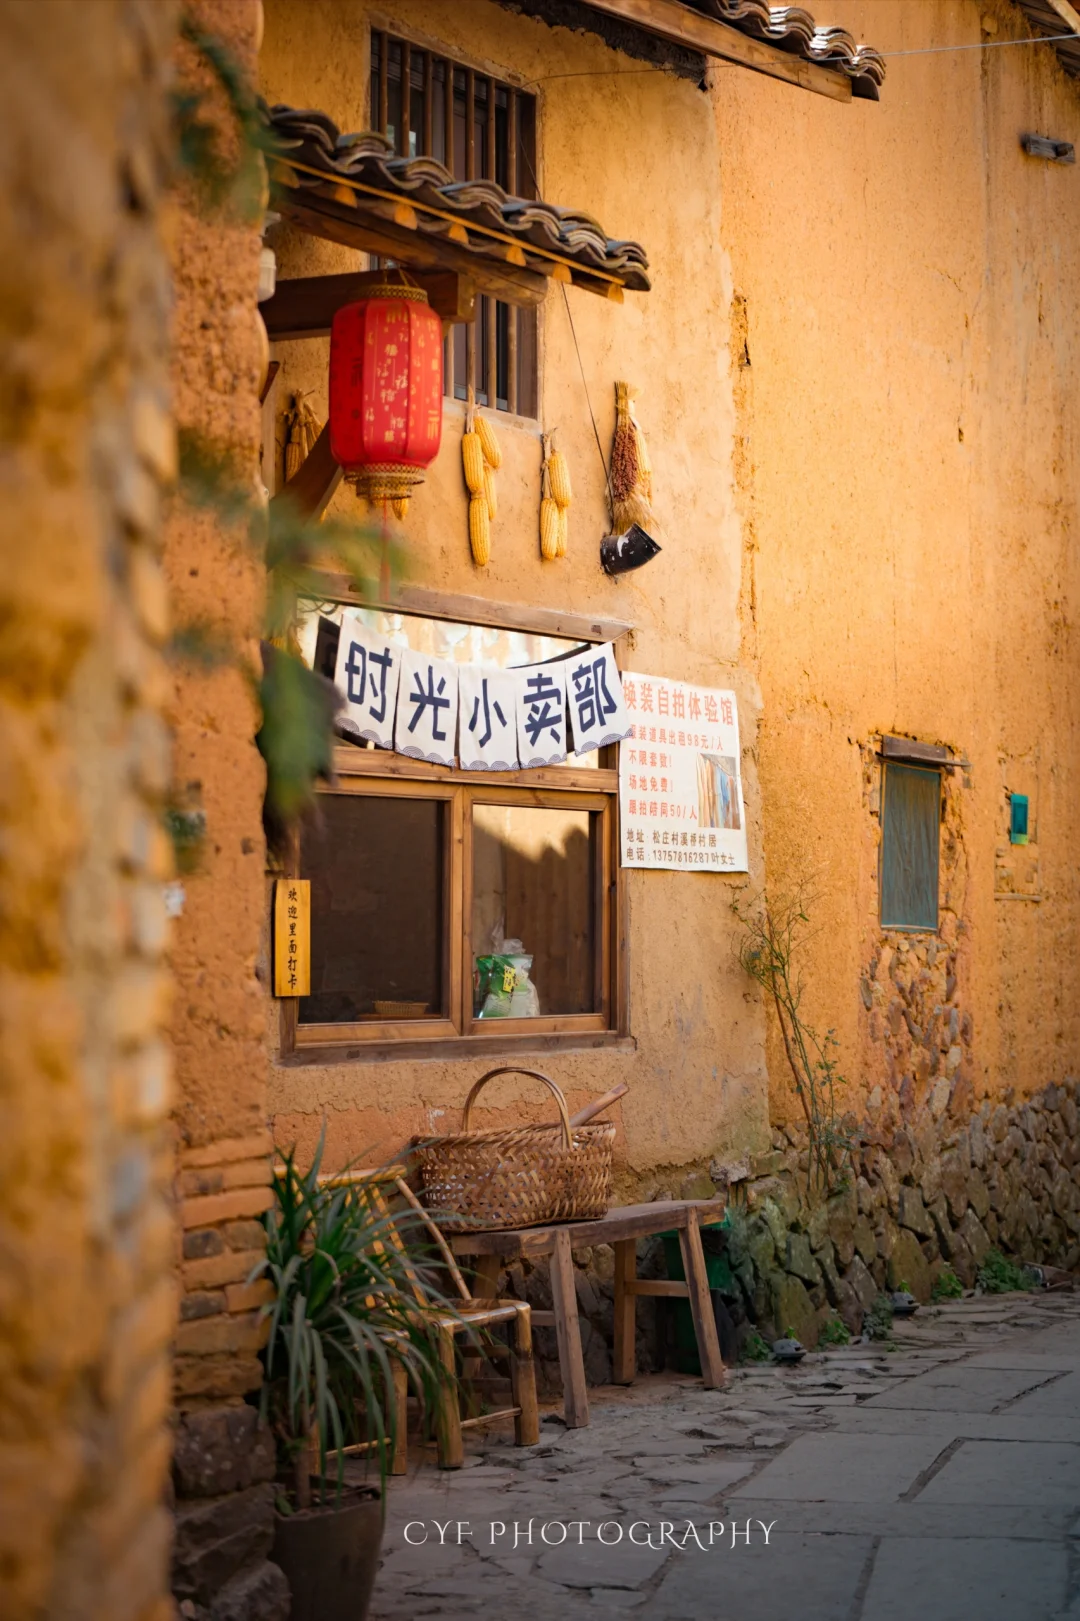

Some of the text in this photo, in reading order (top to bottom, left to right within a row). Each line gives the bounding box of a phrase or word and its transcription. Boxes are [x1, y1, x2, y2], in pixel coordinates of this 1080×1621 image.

[344, 639, 618, 748] 时光小卖部
[623, 680, 734, 726] 换装自拍体验馆
[287, 887, 298, 990] 欢迎里面打卡
